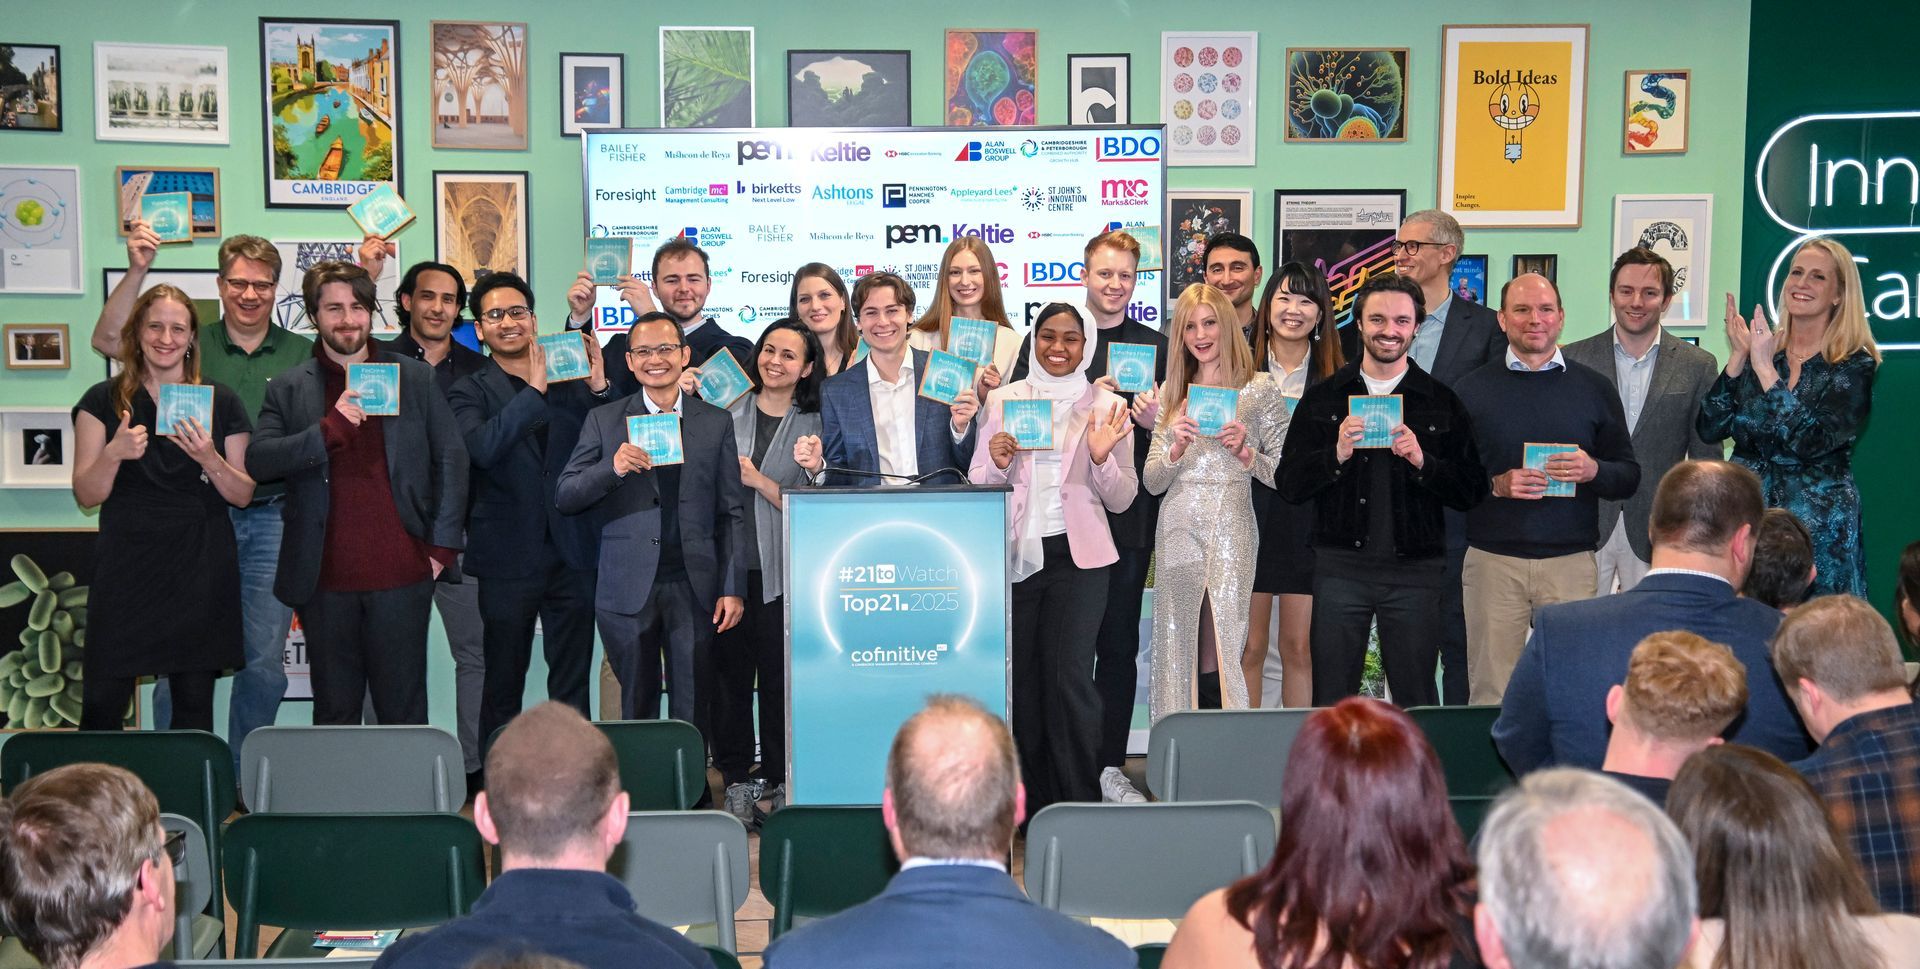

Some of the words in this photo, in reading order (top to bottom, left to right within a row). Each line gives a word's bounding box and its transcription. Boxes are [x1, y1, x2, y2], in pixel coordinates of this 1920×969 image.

[1473, 69, 1510, 85] Bold
[1517, 69, 1558, 85] Ideas
[600, 144, 639, 153] BAILEY
[1103, 136, 1160, 156] BDO
[609, 153, 646, 161] FISHER
[292, 182, 376, 195] CAMBRIDGE
[664, 186, 708, 196] Cambridge
[752, 183, 802, 194] birketts
[812, 184, 874, 200] Ashtons
[950, 187, 993, 198] Appleyard
[994, 187, 1013, 196] Lees
[1058, 186, 1082, 194] JOHN'S
[1101, 179, 1149, 199] m&c
[595, 188, 657, 204] Foresight
[1048, 203, 1074, 211] CENTRE
[749, 224, 786, 234] BAILEY
[757, 233, 794, 242] FISHER
[905, 264, 913, 272] ST
[741, 270, 795, 285] Foresigh
[908, 281, 930, 289] ENTRE
[602, 306, 638, 326] BD
[1125, 301, 1158, 322] ltie
[851, 646, 938, 663] cofinitive
